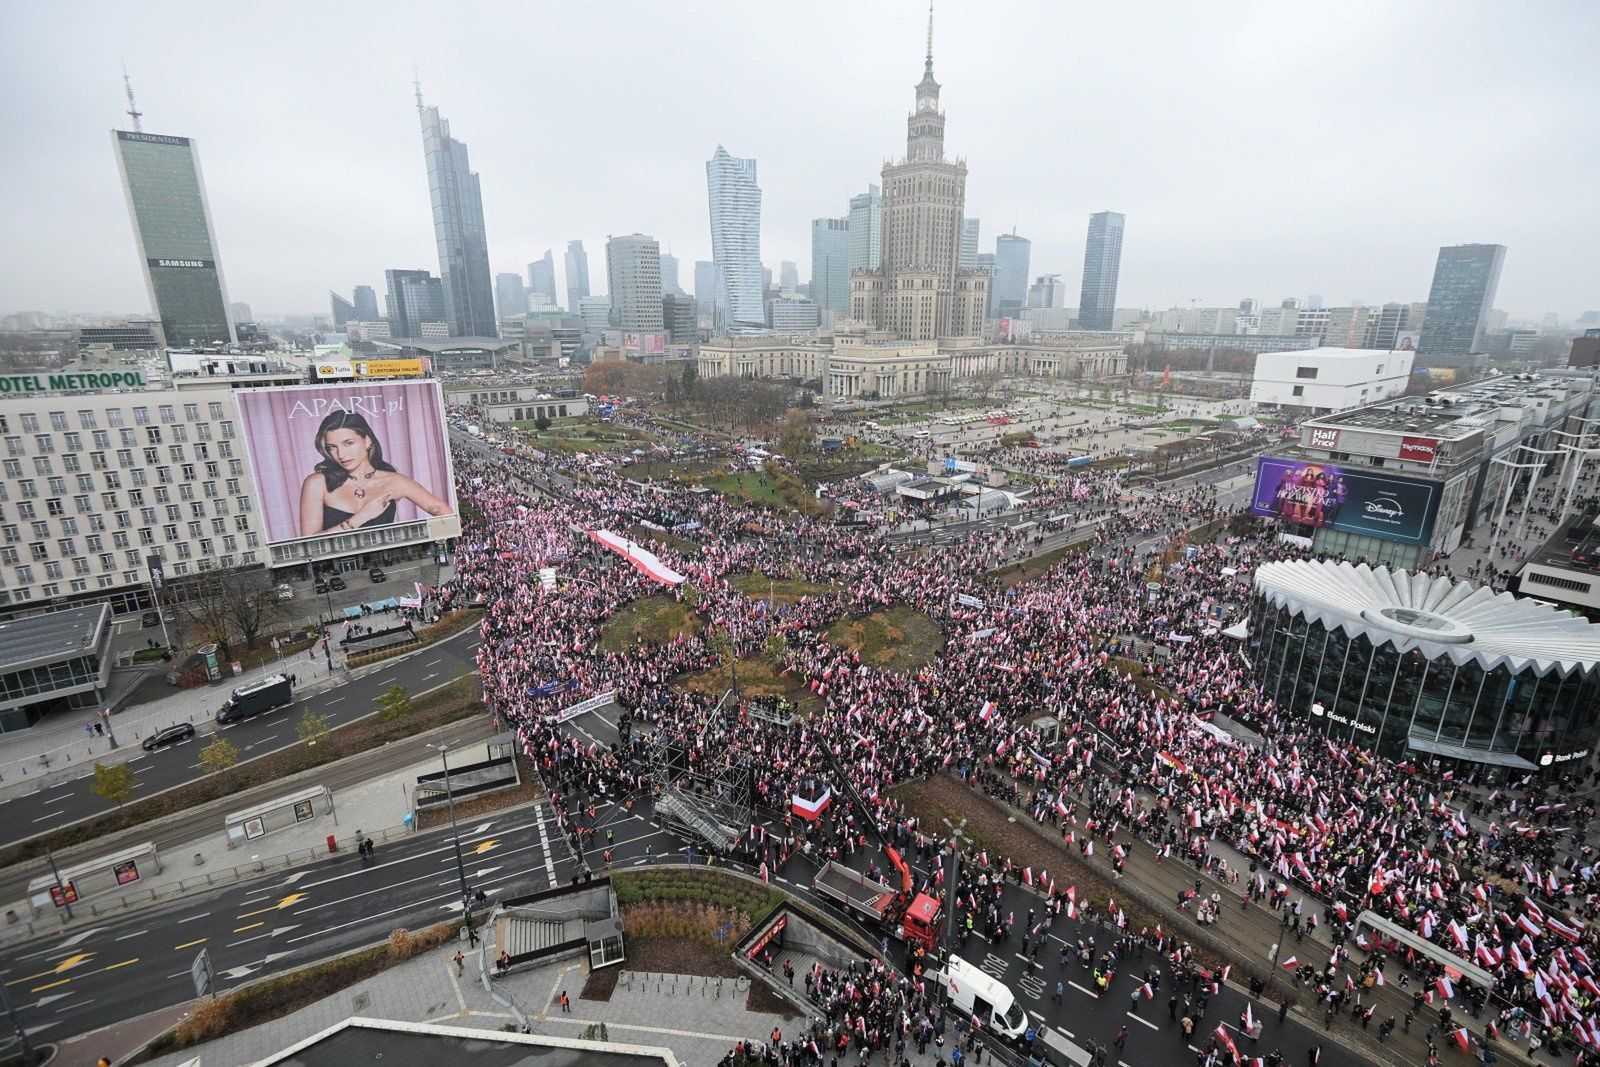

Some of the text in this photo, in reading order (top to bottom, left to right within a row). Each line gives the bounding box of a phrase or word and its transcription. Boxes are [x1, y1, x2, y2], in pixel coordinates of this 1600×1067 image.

[158, 259, 204, 267] SAMSUNG
[49, 372, 147, 391] METROPOL
[1313, 429, 1338, 440] Half
[1311, 437, 1335, 448] Price
[1327, 711, 1376, 734] Bank Polski
[1555, 748, 1589, 762] Bank Polski
[980, 953, 1010, 979] BUS
